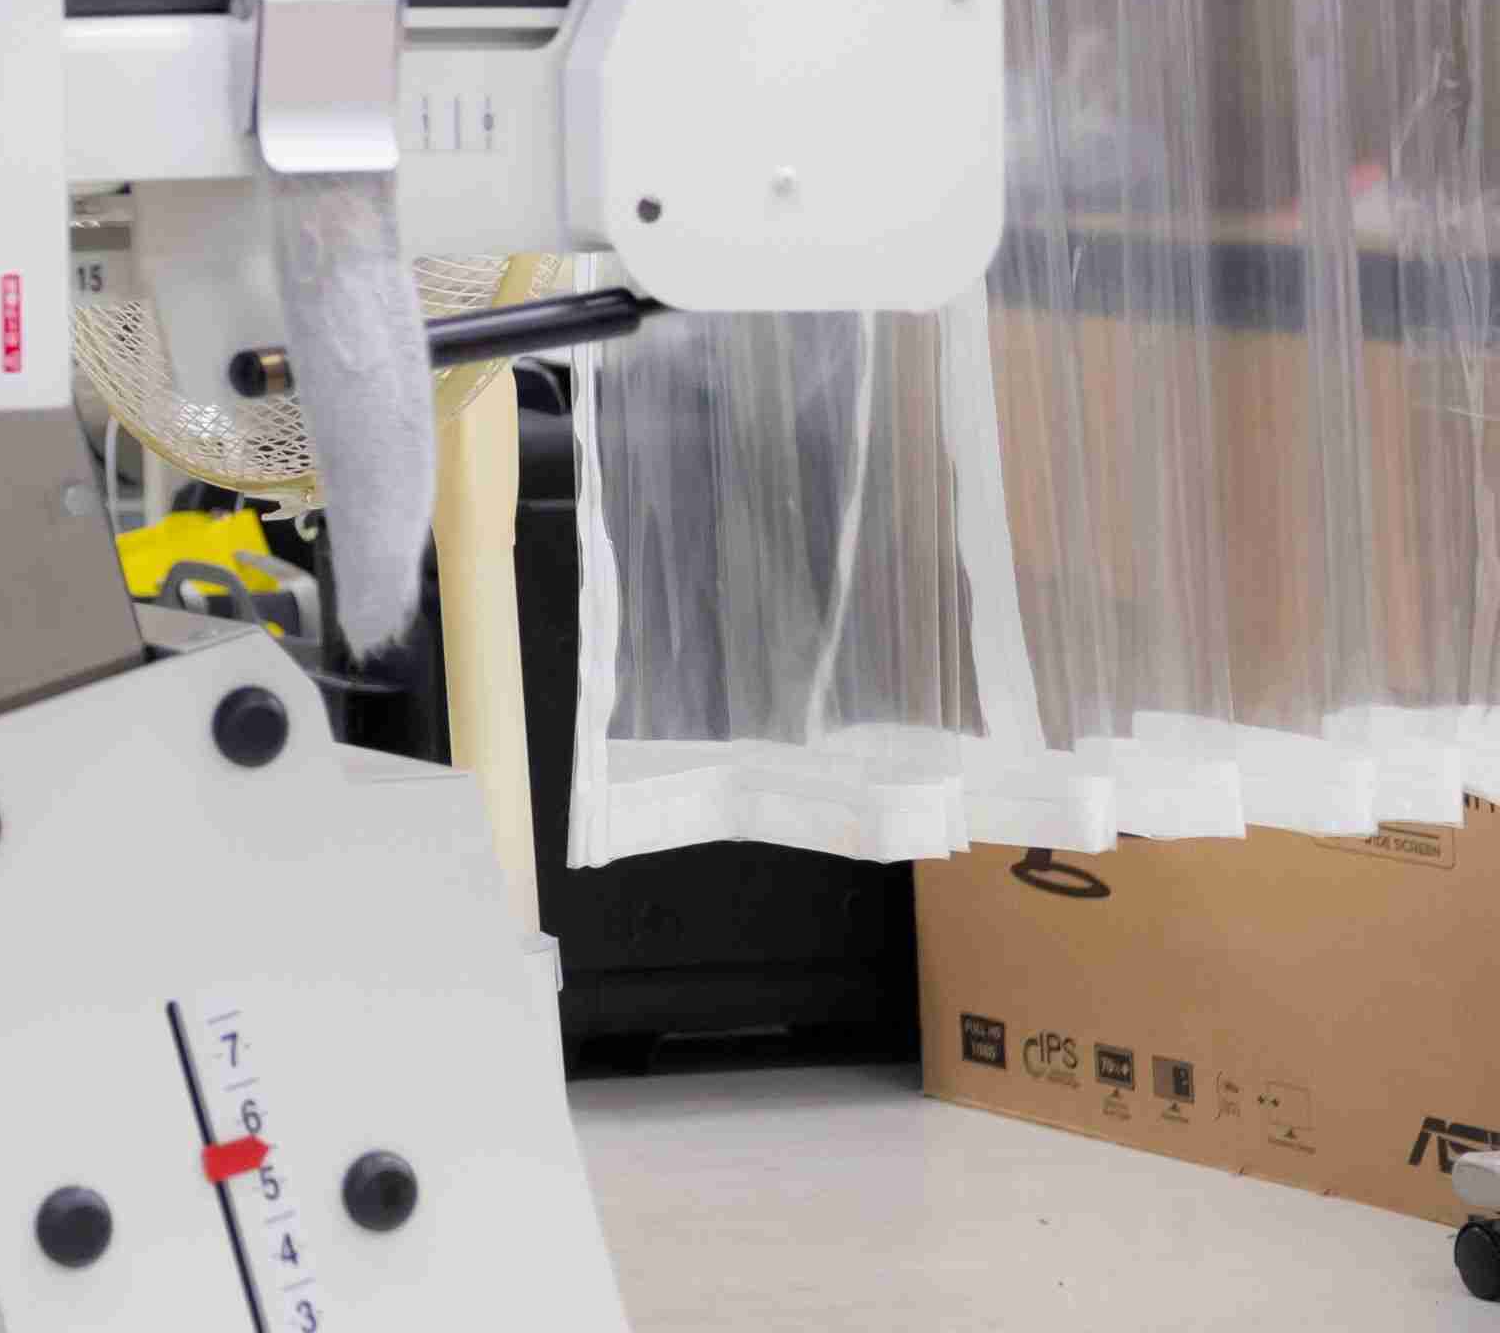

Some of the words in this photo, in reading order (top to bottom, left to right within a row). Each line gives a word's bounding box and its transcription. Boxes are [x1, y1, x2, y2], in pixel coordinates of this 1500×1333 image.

[76, 264, 103, 293] 15
[220, 1032, 239, 1067] 7
[240, 1099, 262, 1134] 6
[259, 1166, 280, 1201] 5
[280, 1233, 299, 1266] 4
[296, 1300, 318, 1333] 3
